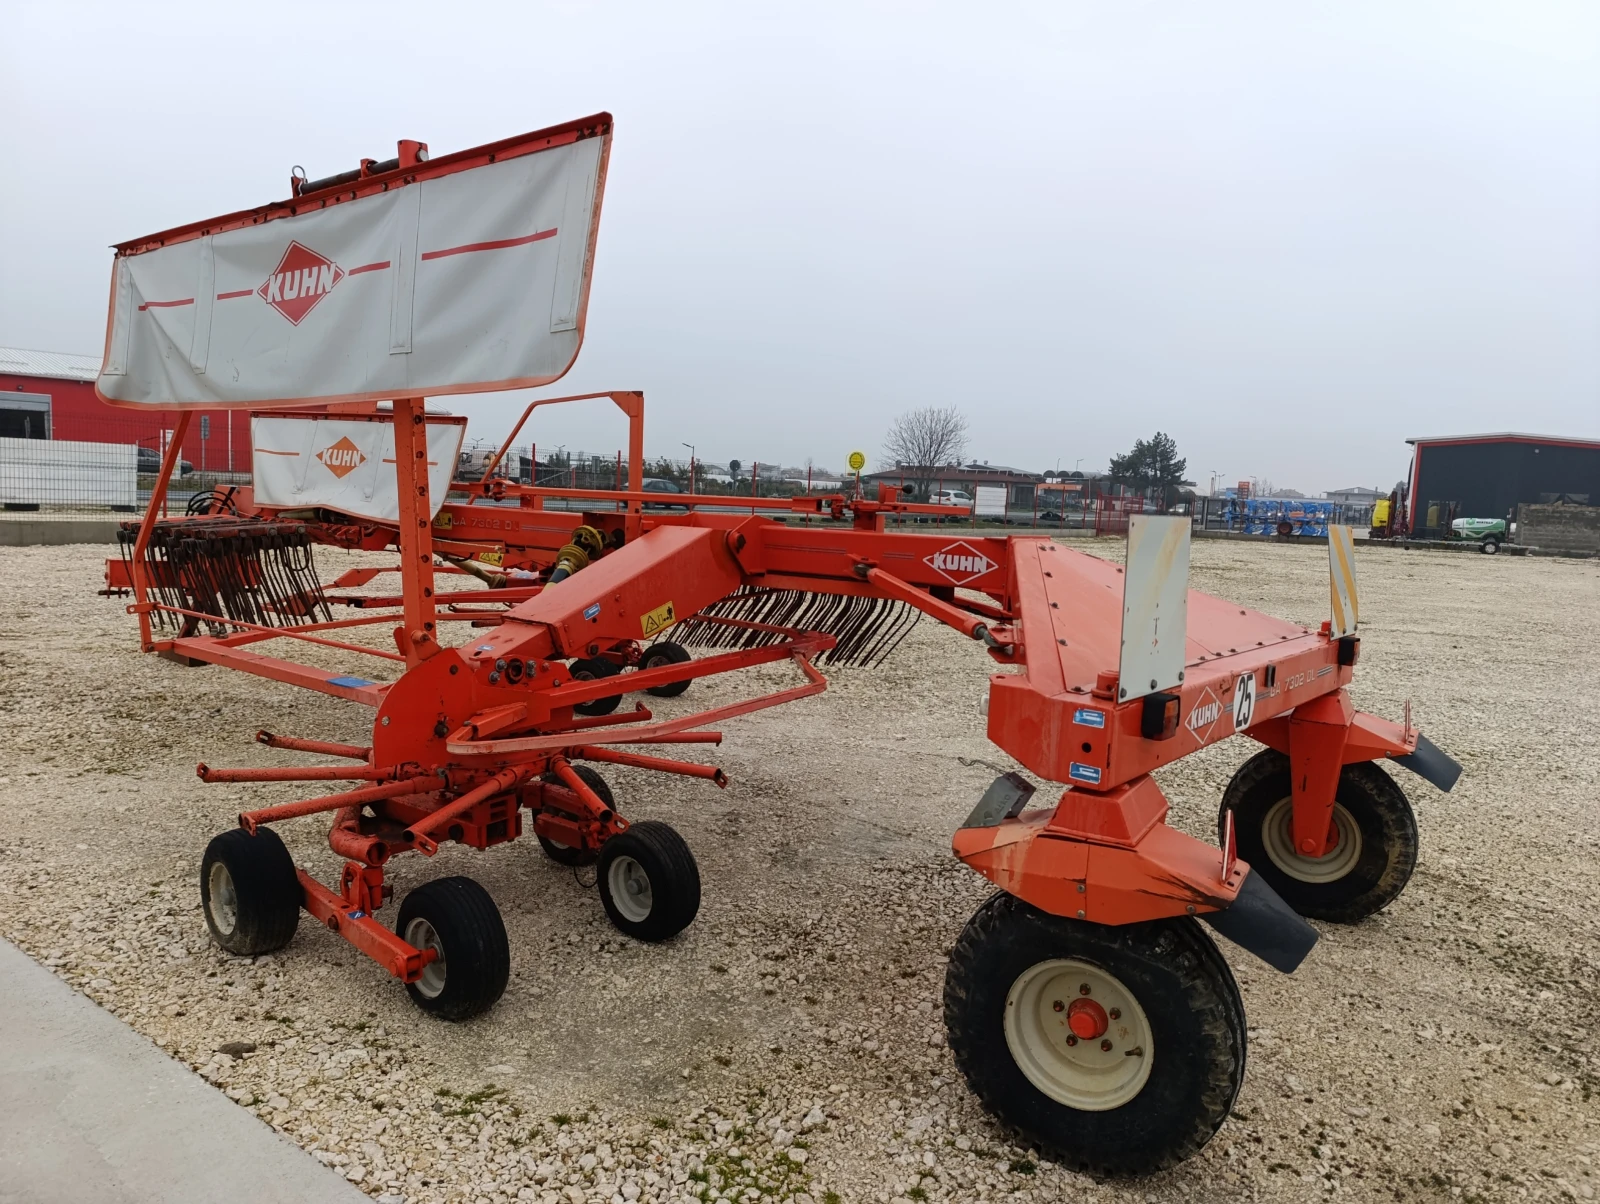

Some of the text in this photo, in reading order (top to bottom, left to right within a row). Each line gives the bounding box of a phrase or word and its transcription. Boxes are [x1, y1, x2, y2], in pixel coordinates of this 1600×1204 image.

[266, 262, 337, 304] KUHN
[321, 448, 361, 467] KUHN
[471, 517, 500, 530] 7302
[933, 552, 988, 573] KUHN
[1284, 672, 1304, 692] 7302
[1306, 669, 1316, 683] DL
[1235, 673, 1253, 728] 25
[1190, 701, 1219, 730] KUHN
